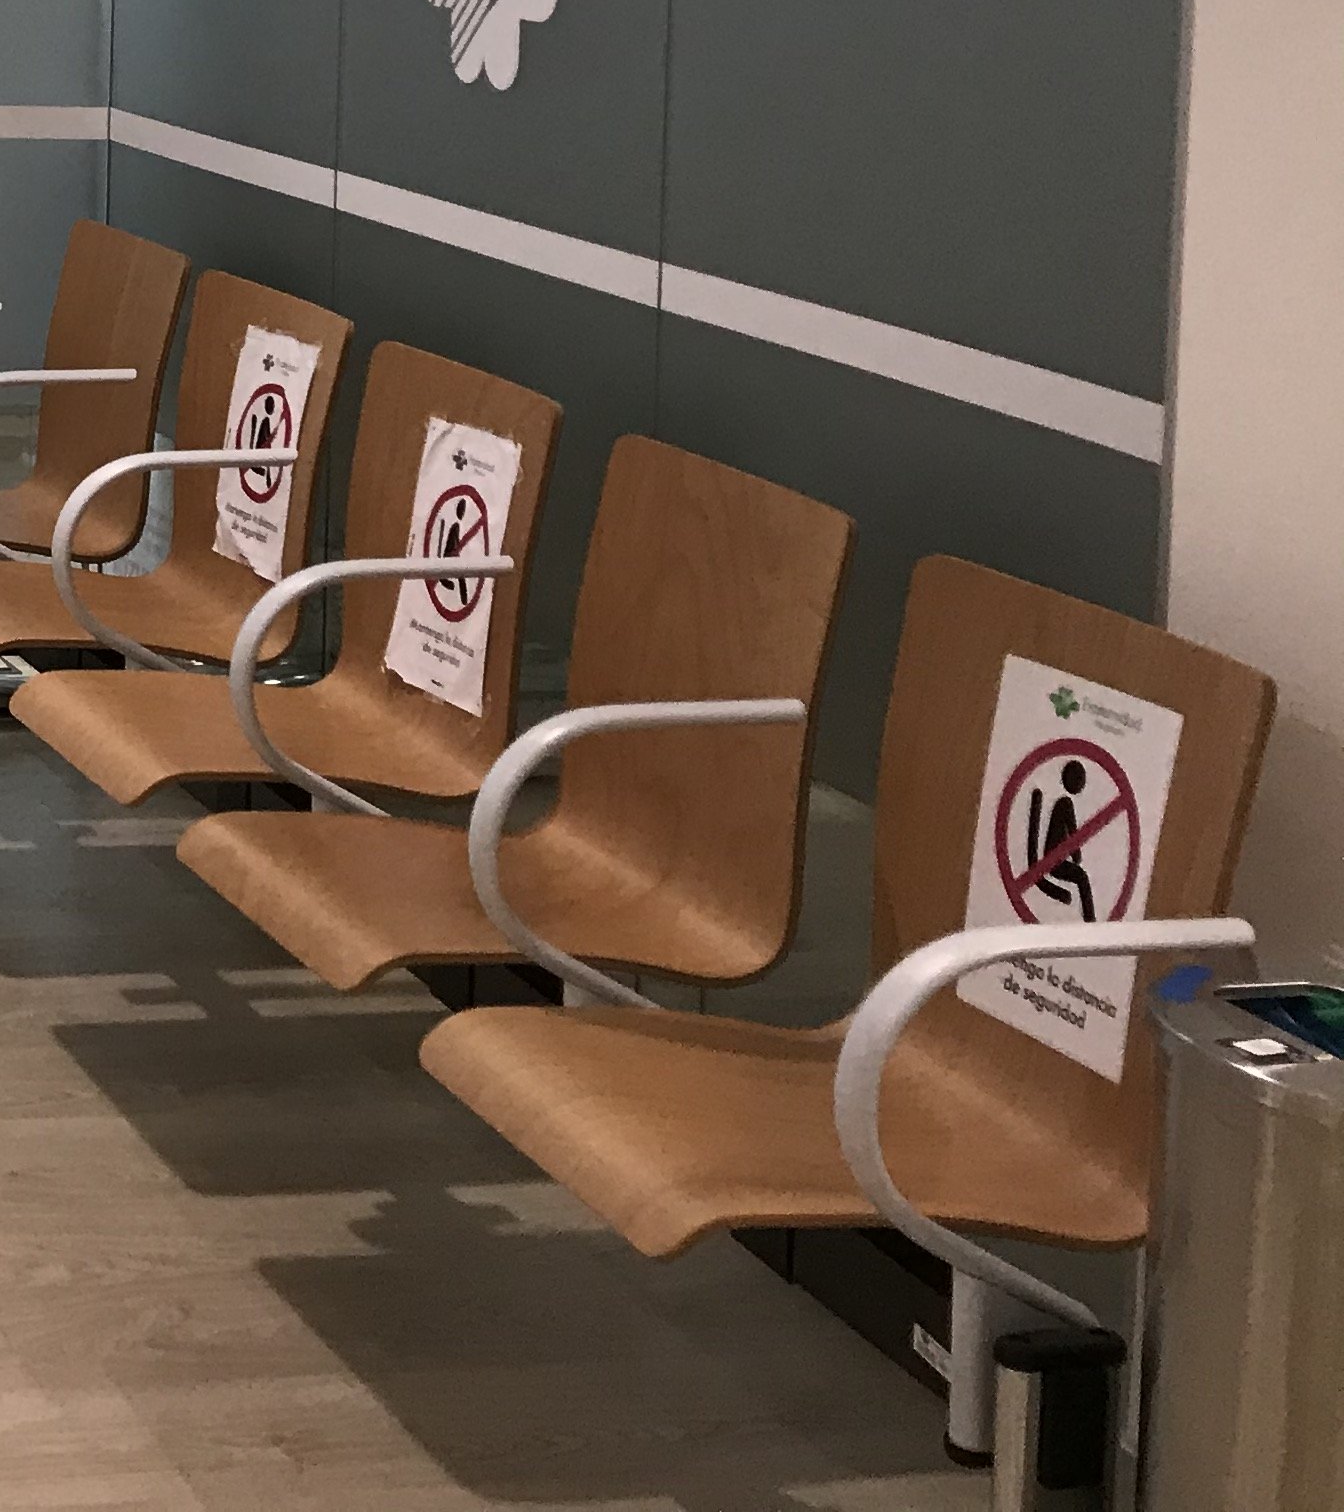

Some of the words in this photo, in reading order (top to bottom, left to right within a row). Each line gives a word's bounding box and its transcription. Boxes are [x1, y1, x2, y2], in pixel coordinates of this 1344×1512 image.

[1004, 973, 1020, 994] de
[1023, 988, 1087, 1029] seguridad
[1047, 965, 1060, 988] la
[1062, 975, 1117, 1018] distancia
